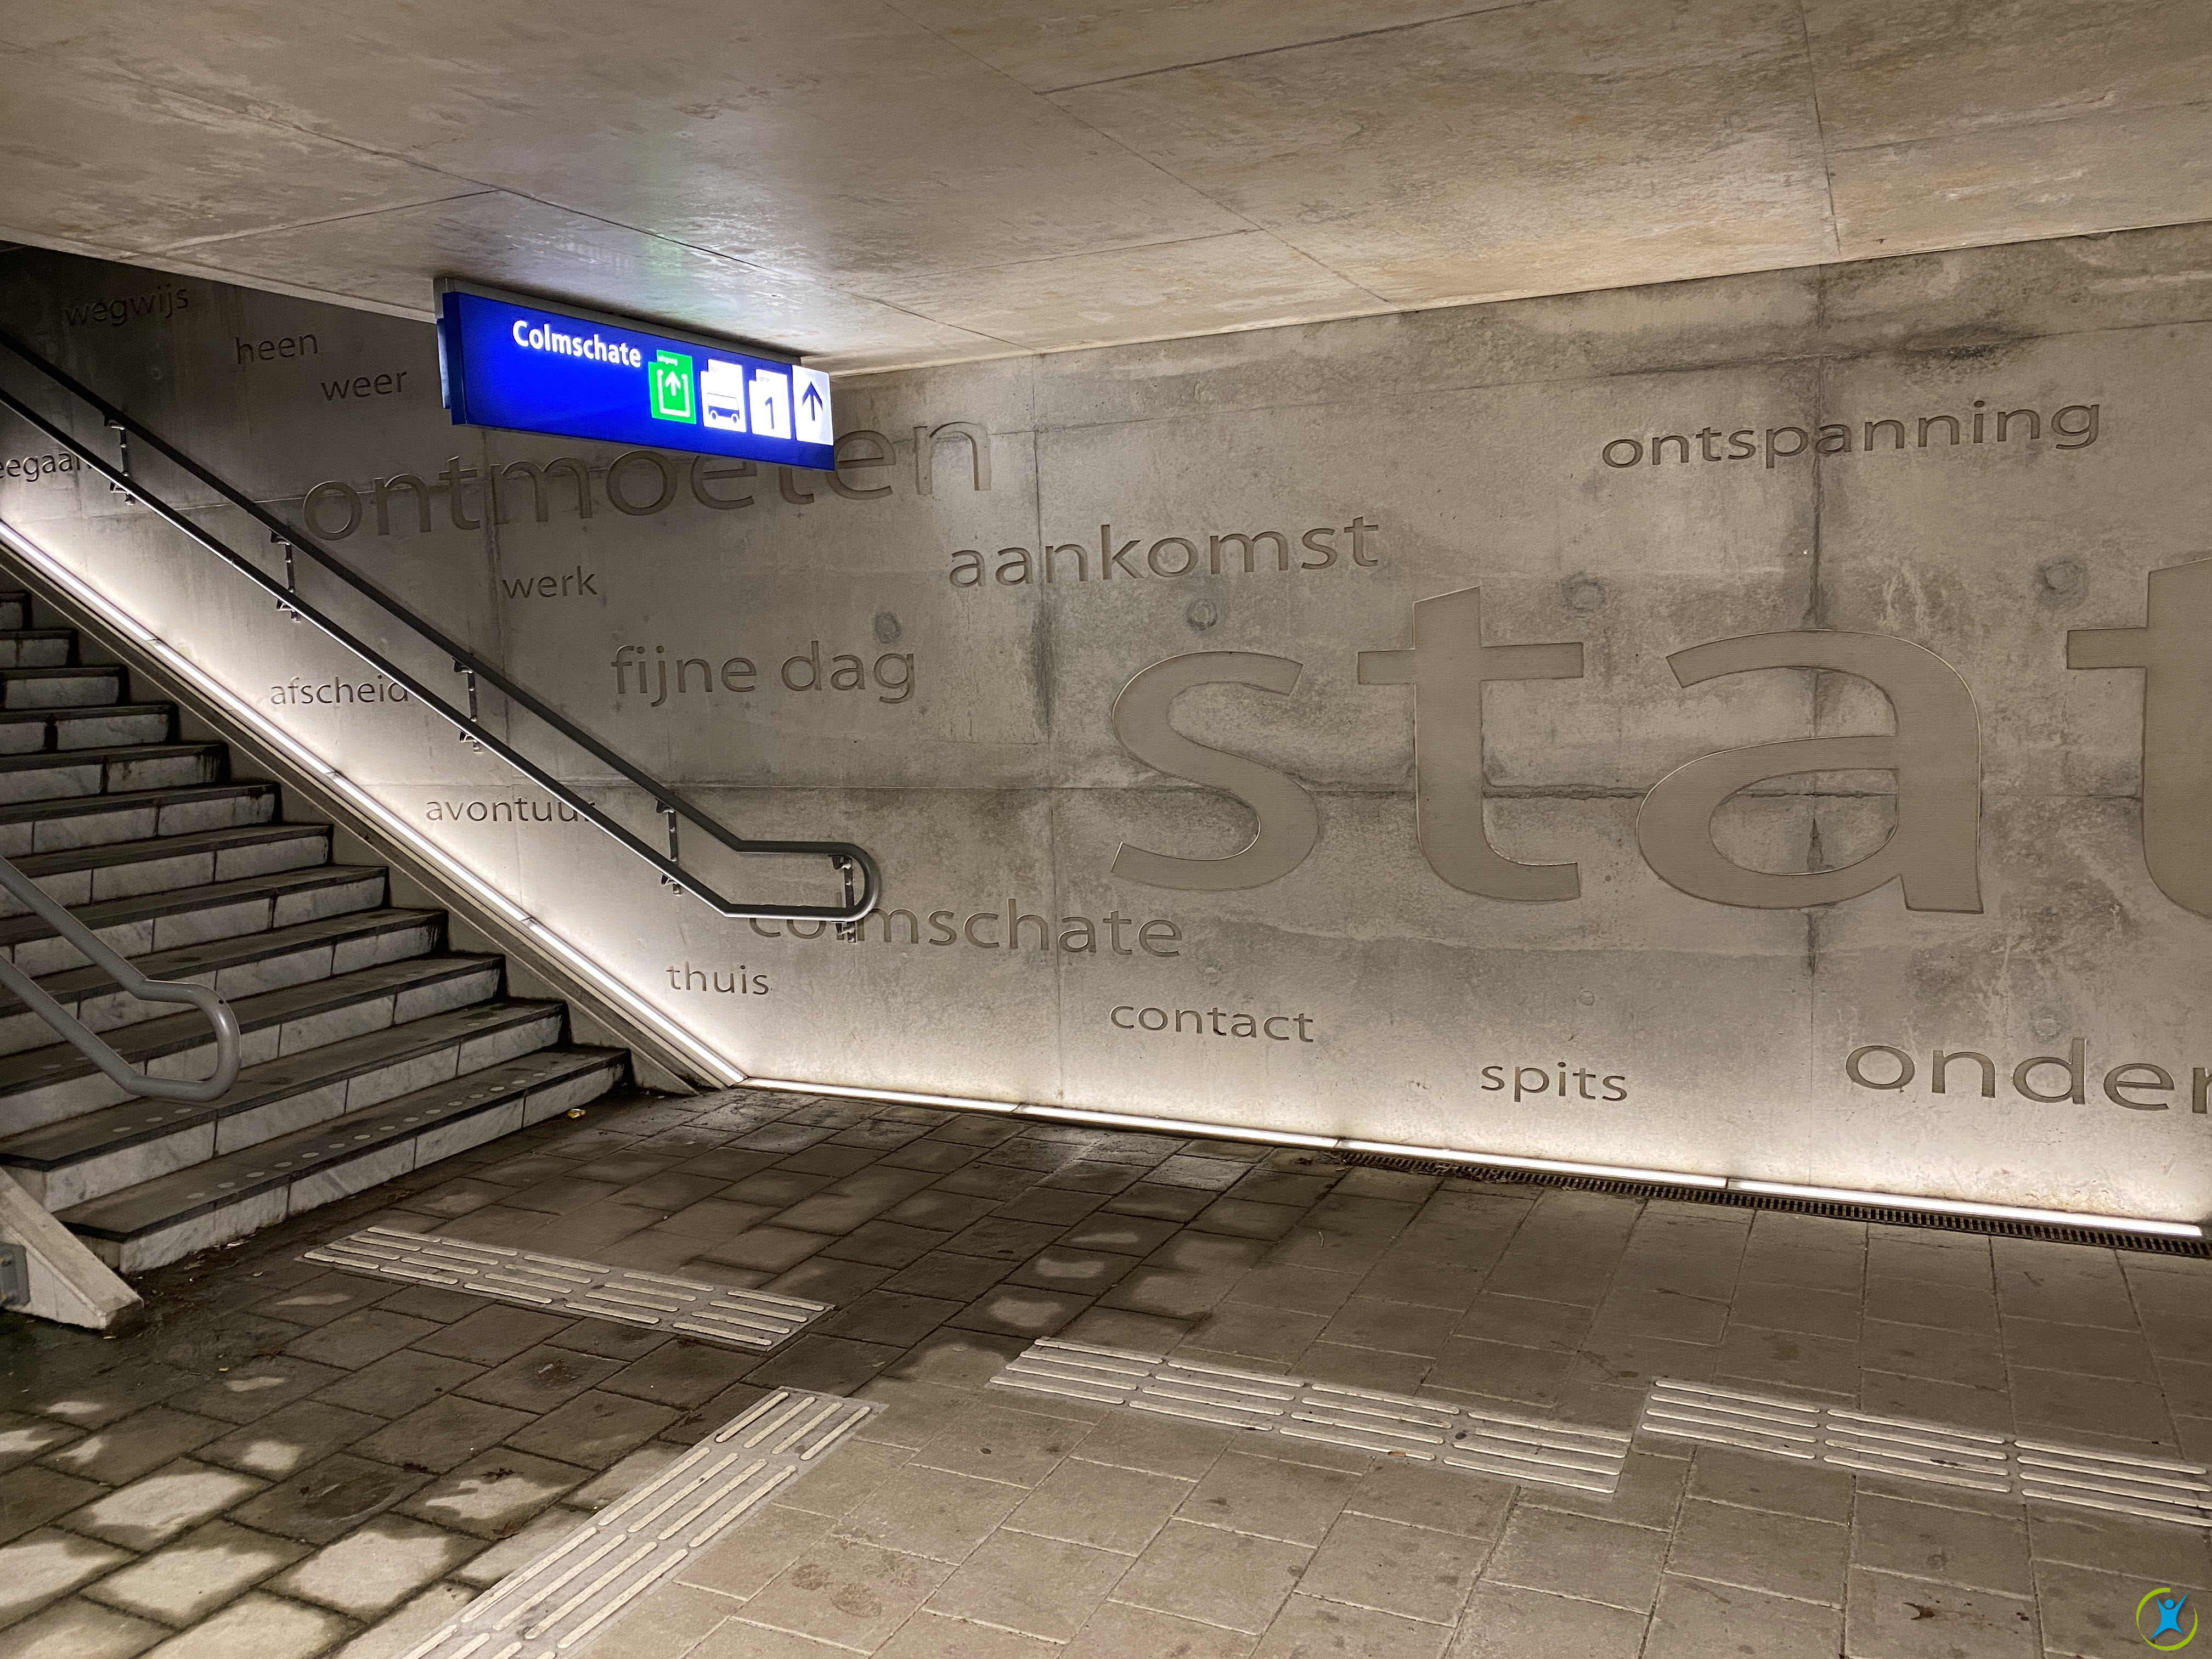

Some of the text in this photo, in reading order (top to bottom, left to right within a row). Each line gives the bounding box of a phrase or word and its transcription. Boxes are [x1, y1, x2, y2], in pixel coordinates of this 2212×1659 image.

[63, 285, 189, 327] wegwijs
[235, 332, 319, 364] heen
[512, 320, 641, 368] Colmschate
[321, 369, 408, 401] weer
[765, 397, 775, 429] 1
[1601, 401, 2100, 470] ontspanning
[0, 453, 92, 482] egaa
[949, 516, 1379, 588] aankomst
[502, 566, 598, 600] werk
[611, 640, 915, 707] fijne dag
[425, 797, 595, 822] avontuu
[665, 961, 769, 996] thuis
[1110, 1001, 1314, 1043] contact
[1481, 1062, 1627, 1103] spits
